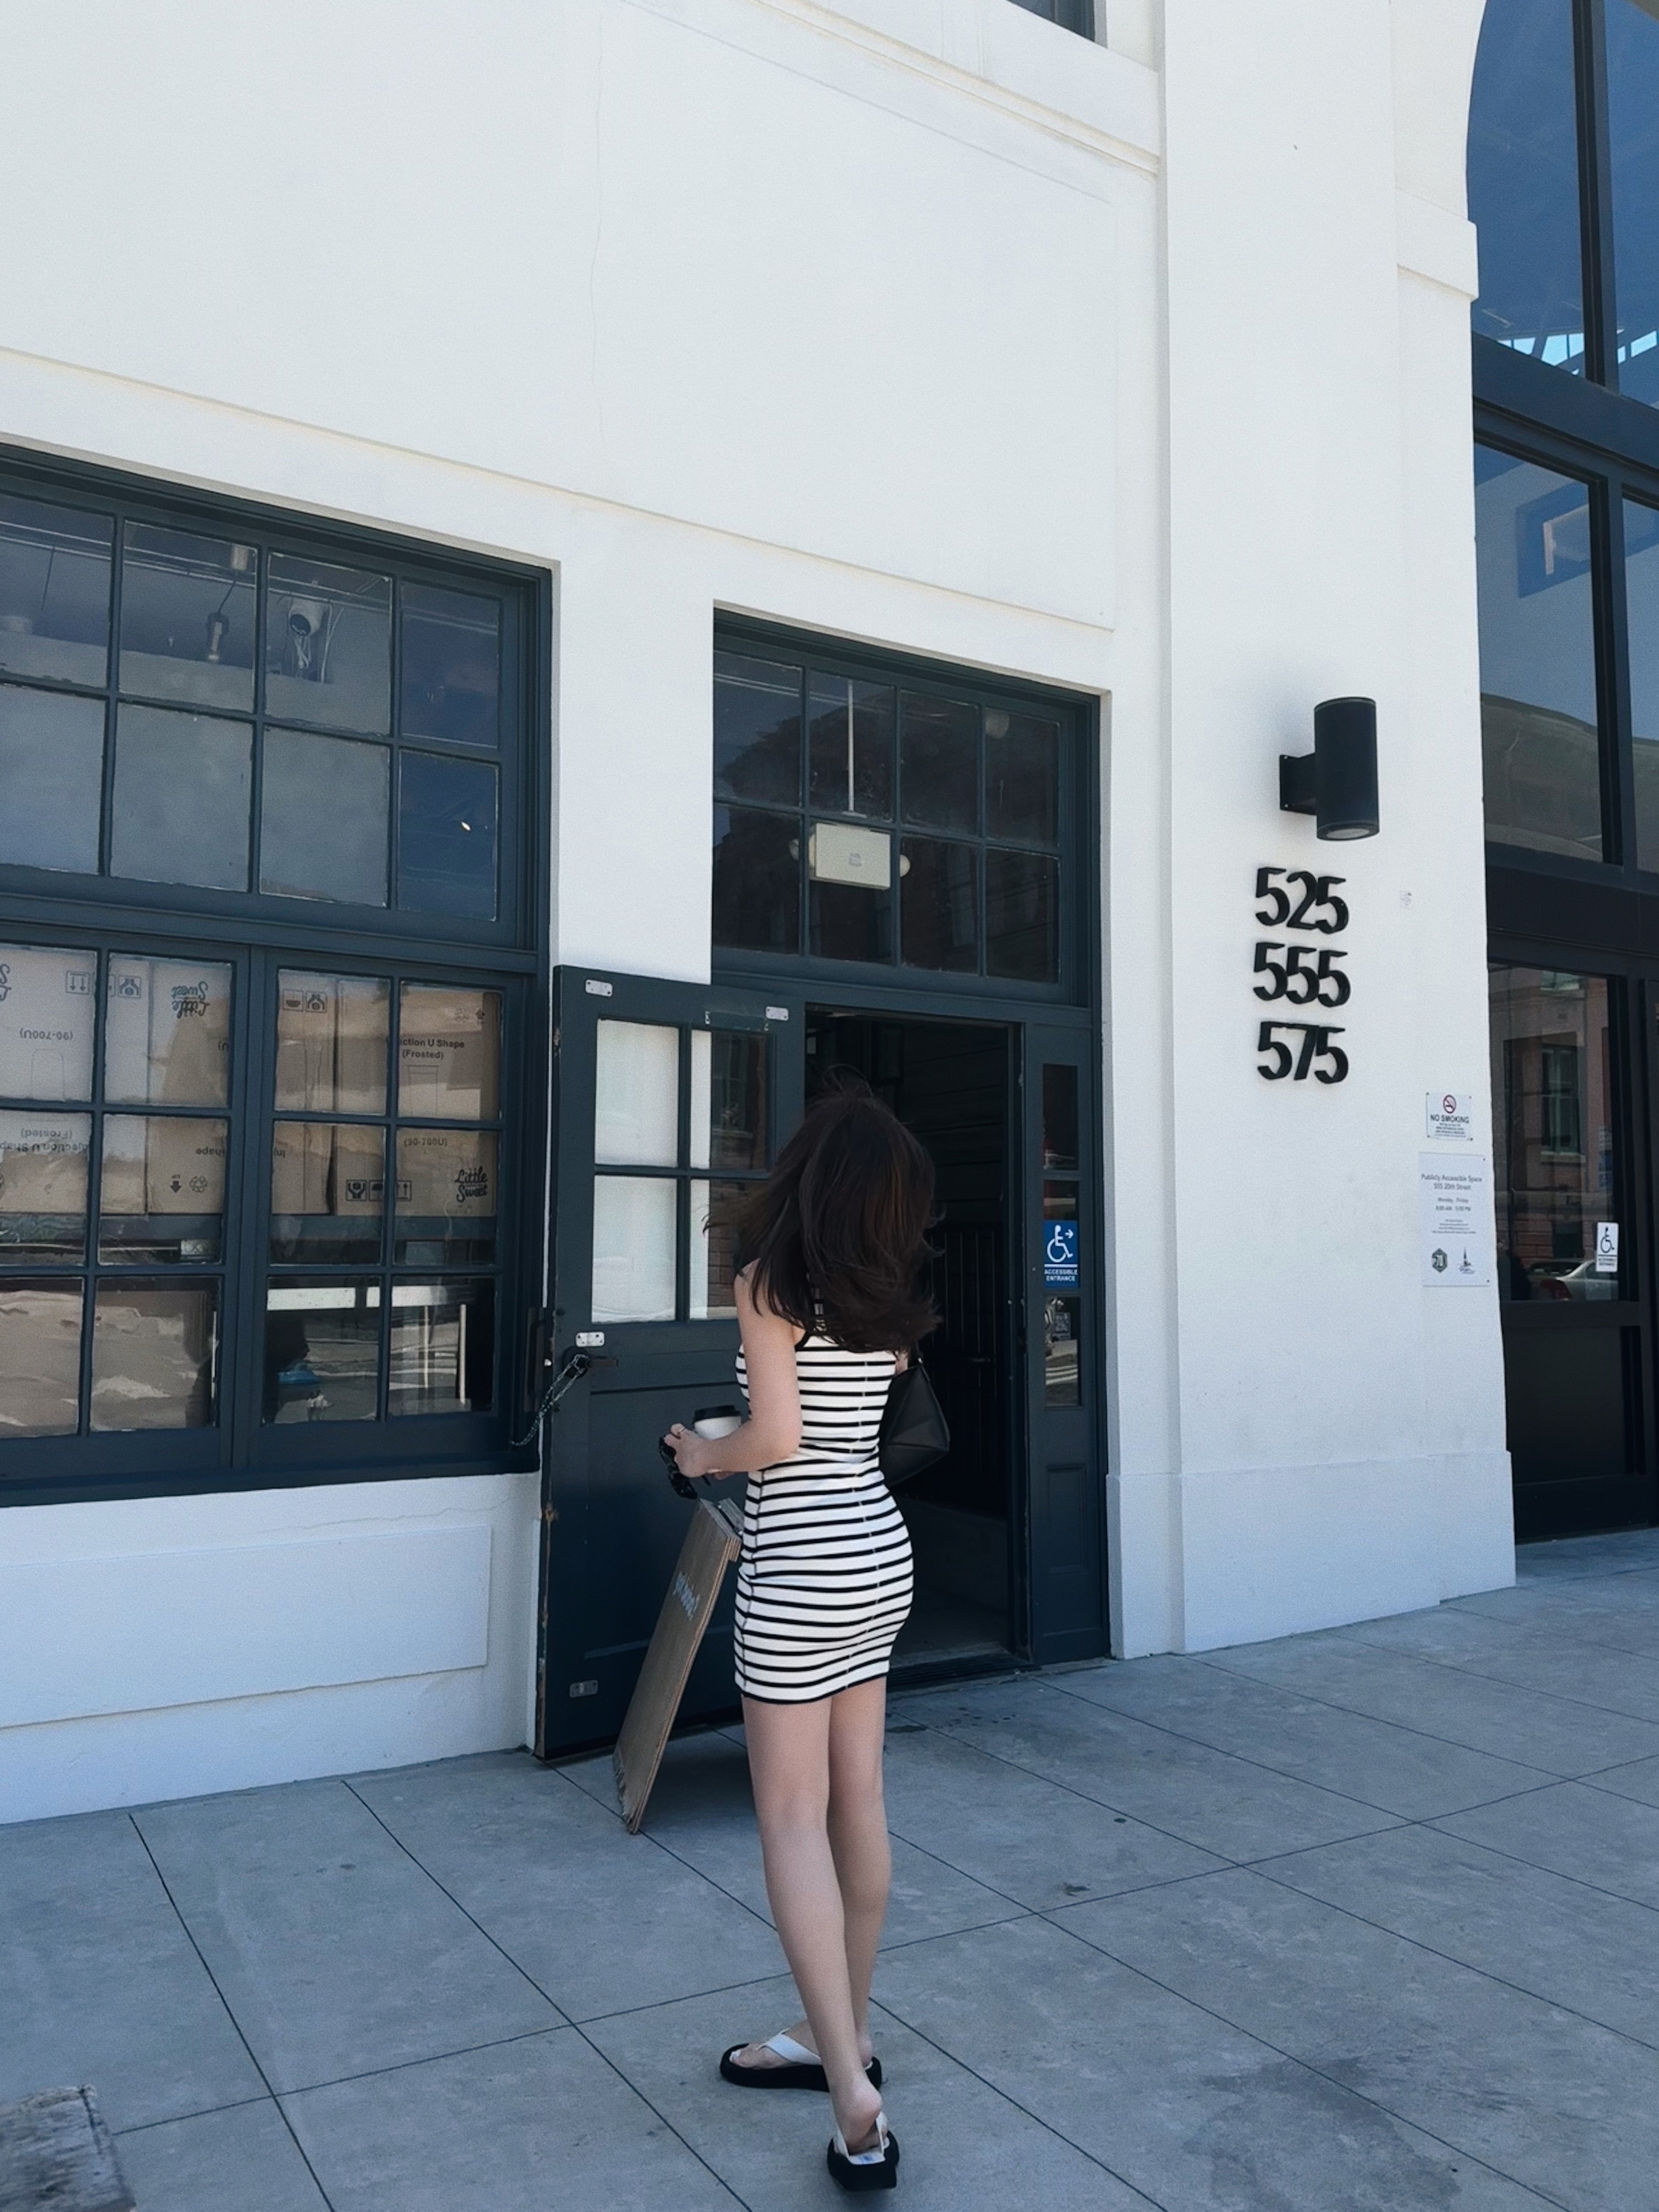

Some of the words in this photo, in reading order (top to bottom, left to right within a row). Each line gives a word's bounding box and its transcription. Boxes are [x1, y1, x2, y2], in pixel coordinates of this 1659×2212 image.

[1255, 866, 1349, 934] 525
[1252, 941, 1351, 1008] 555
[171, 981, 208, 1000] Sweet
[171, 1001, 211, 1019] Little
[20, 1028, 74, 1041] (90-700U)
[400, 1038, 426, 1046] ction
[428, 1039, 435, 1047] U
[437, 1039, 465, 1049] Shape
[403, 1049, 444, 1060] (Frosted)
[1257, 1020, 1349, 1084] 575
[1441, 1115, 1469, 1123] SMOKING
[21, 1129, 73, 1139] (Frosted)
[0, 1141, 29, 1152] Shap
[454, 1164, 488, 1183] Little
[456, 1183, 488, 1203] Sweet
